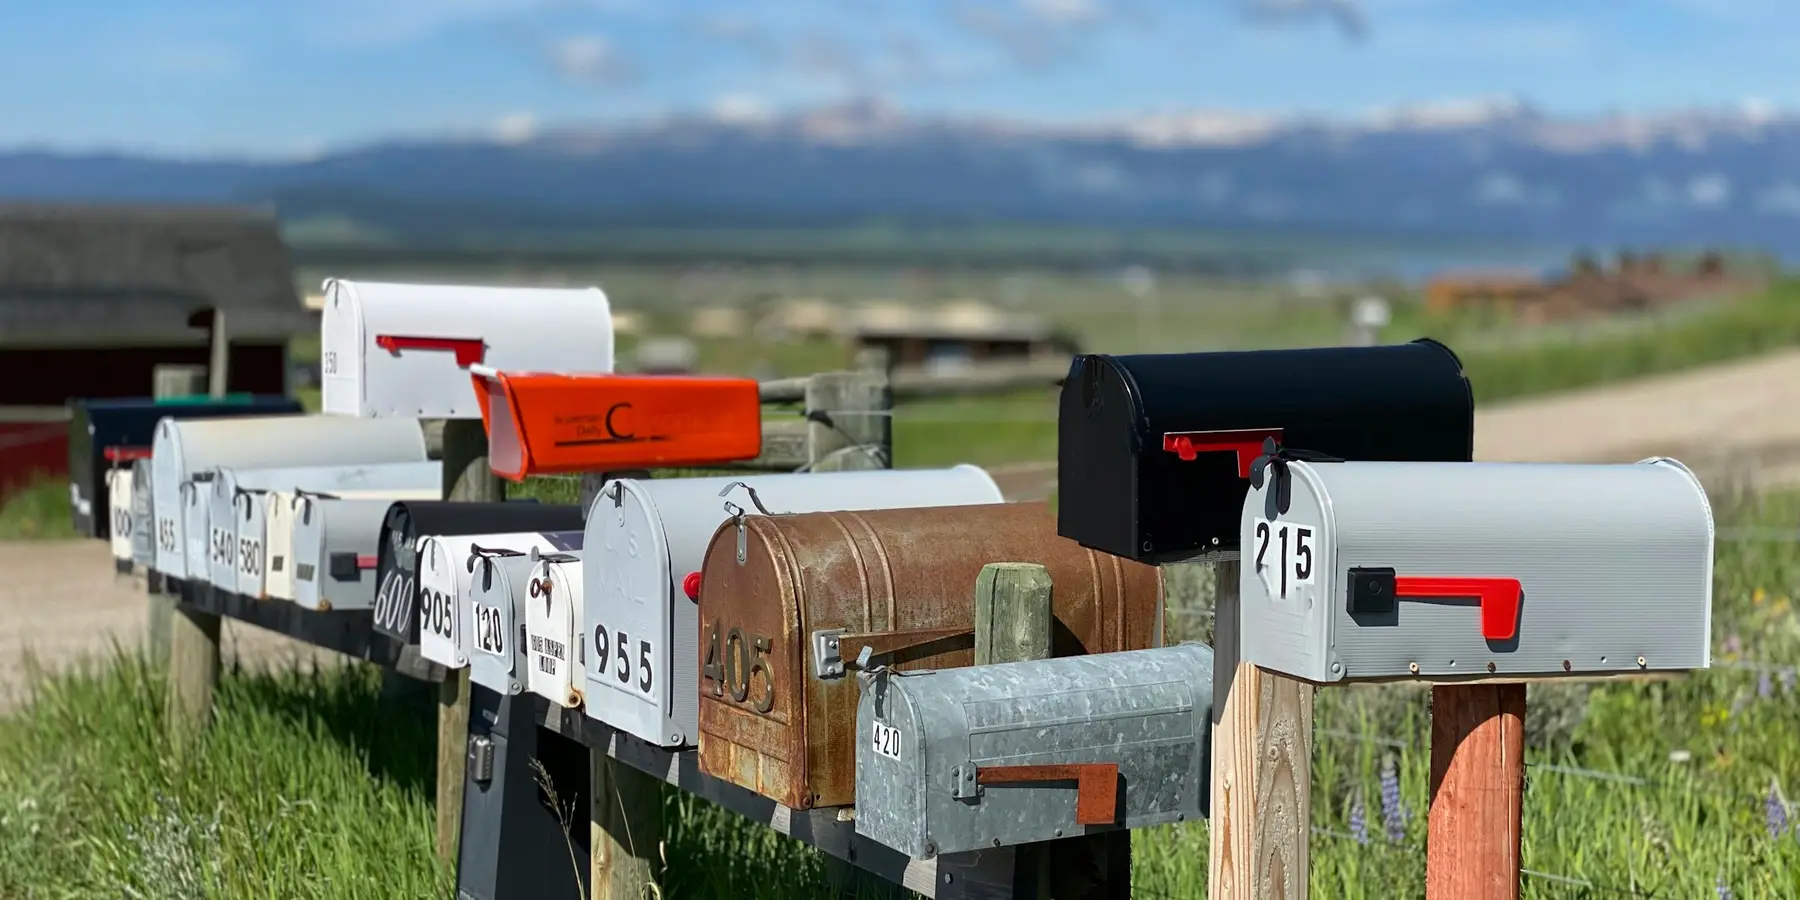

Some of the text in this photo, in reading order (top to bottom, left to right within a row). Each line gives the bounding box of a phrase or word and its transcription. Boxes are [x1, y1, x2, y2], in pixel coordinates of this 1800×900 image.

[212, 528, 234, 567] 540
[239, 538, 260, 576] 580
[1255, 522, 1313, 599] 215
[375, 569, 414, 634] 600
[420, 587, 453, 639] 905
[475, 602, 504, 654] 120
[544, 637, 566, 661] ASPEN
[538, 654, 557, 676] LOOP
[594, 623, 655, 693] 955
[703, 618, 776, 714] 405
[873, 724, 900, 757] 420
